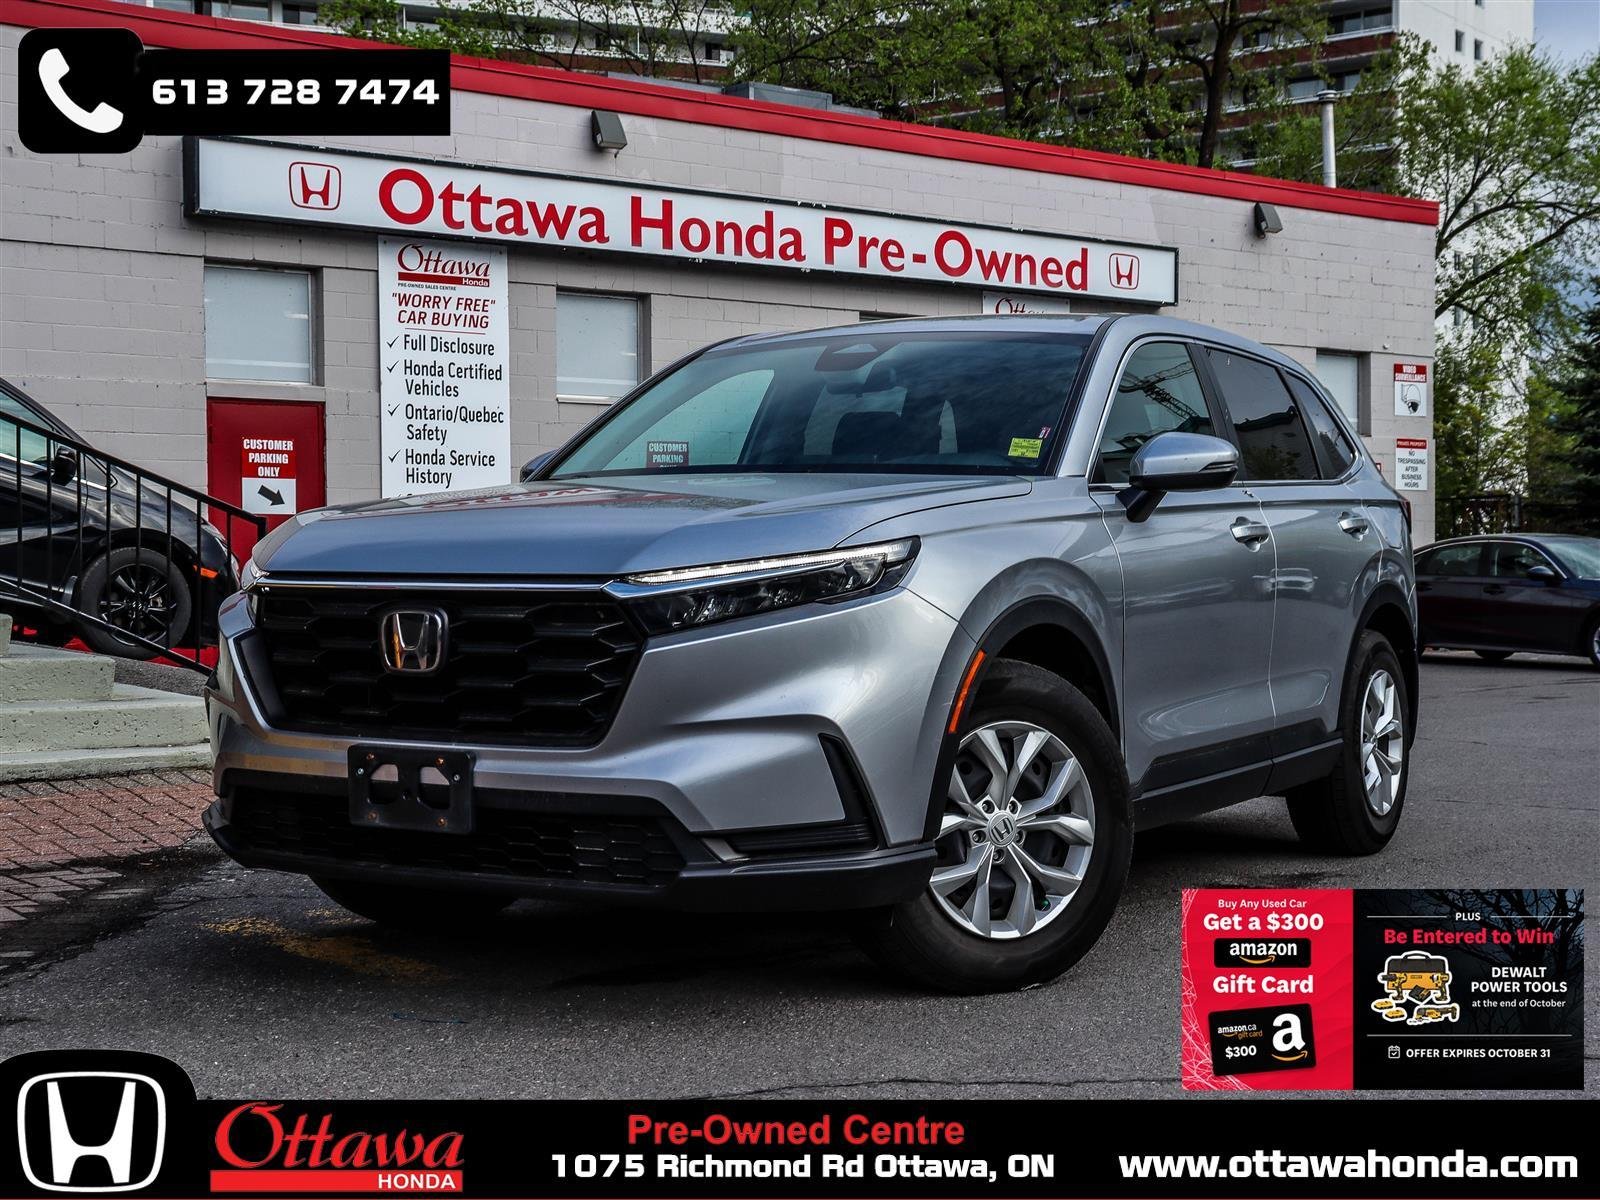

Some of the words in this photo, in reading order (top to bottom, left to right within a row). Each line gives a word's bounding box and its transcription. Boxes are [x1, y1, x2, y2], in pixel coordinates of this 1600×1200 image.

[378, 168, 610, 244] Ottawa
[630, 196, 806, 262] Honda
[824, 217, 1089, 291] Pre-Owned
[398, 244, 490, 277] Ottawa
[462, 278, 489, 287] Honda
[391, 293, 452, 309] "WORRY
[456, 297, 496, 312] FREE"
[397, 310, 427, 325] CAR
[431, 311, 489, 329] BUYING
[404, 335, 426, 352] Full
[431, 336, 495, 355] Disclosure
[404, 359, 444, 377] Honda
[448, 362, 503, 382] Certified
[405, 379, 459, 398] Vehicles
[405, 404, 504, 424] Ontario/Quebec
[407, 424, 448, 446] Safety
[243, 439, 293, 451] CUSTOMER
[649, 443, 687, 452] CUSTOMER
[248, 453, 289, 464] PARKING
[405, 449, 445, 466] Honda
[450, 450, 496, 467] Service
[652, 455, 684, 463] PARKING
[257, 467, 280, 477] ONLY
[406, 468, 452, 489] History
